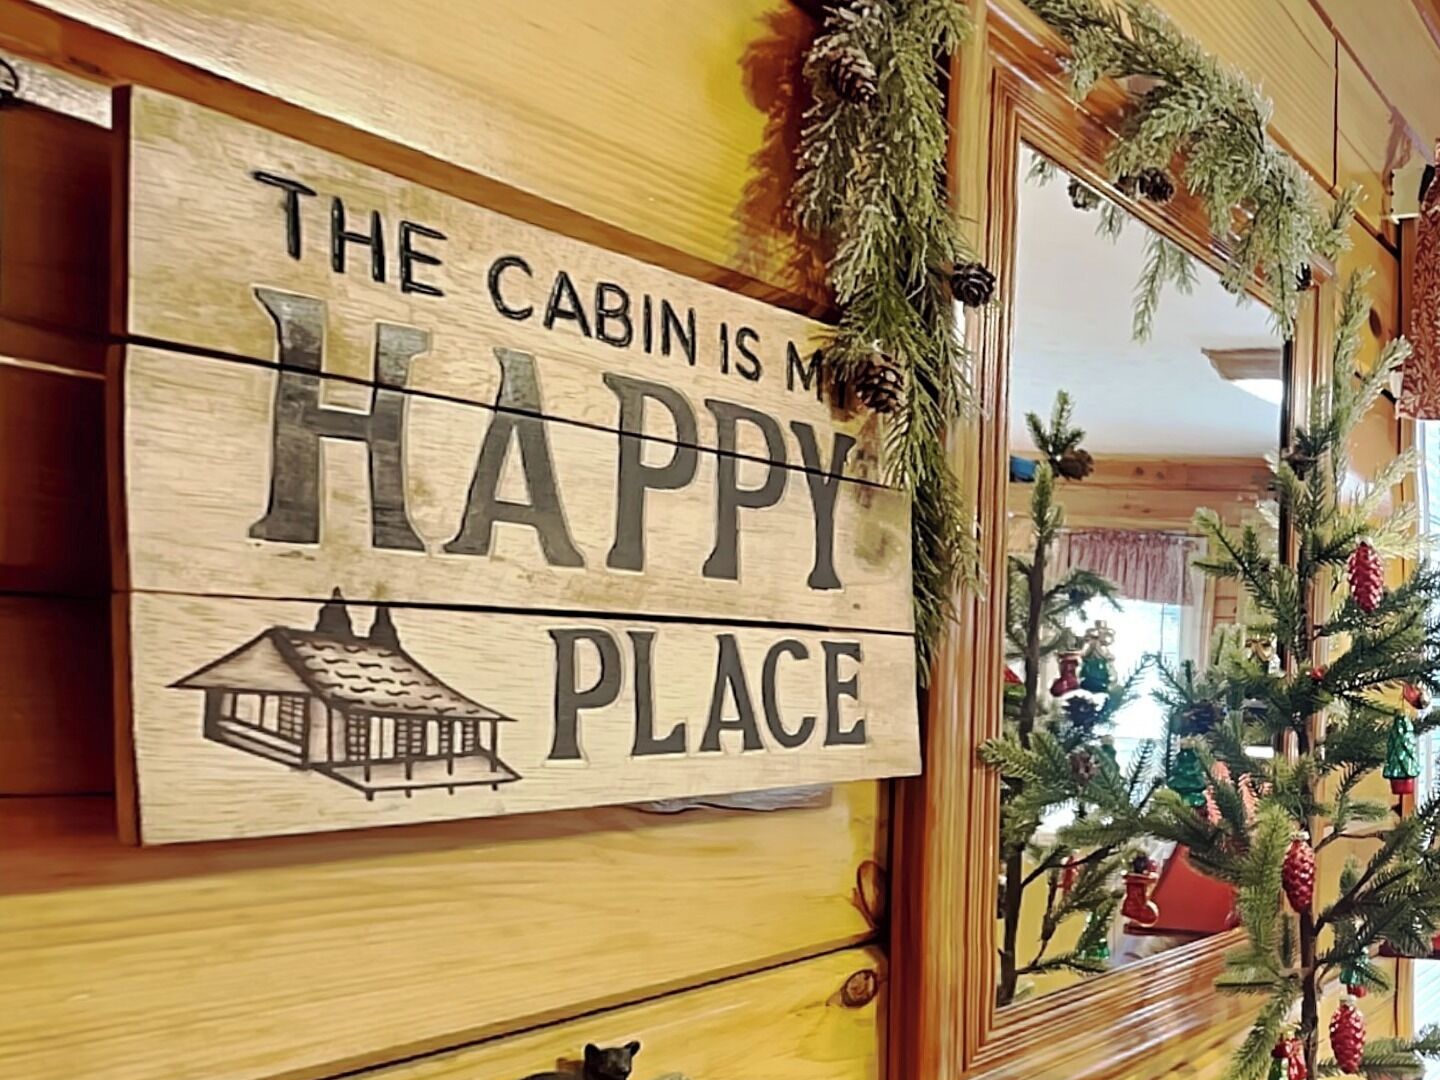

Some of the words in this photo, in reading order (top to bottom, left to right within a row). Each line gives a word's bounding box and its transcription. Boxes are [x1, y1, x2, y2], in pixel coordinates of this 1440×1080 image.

[253, 170, 448, 297] THE
[487, 255, 696, 367] CABIN
[719, 322, 763, 382] IS
[248, 287, 857, 590] HAPPY
[548, 628, 867, 762] PLACE
